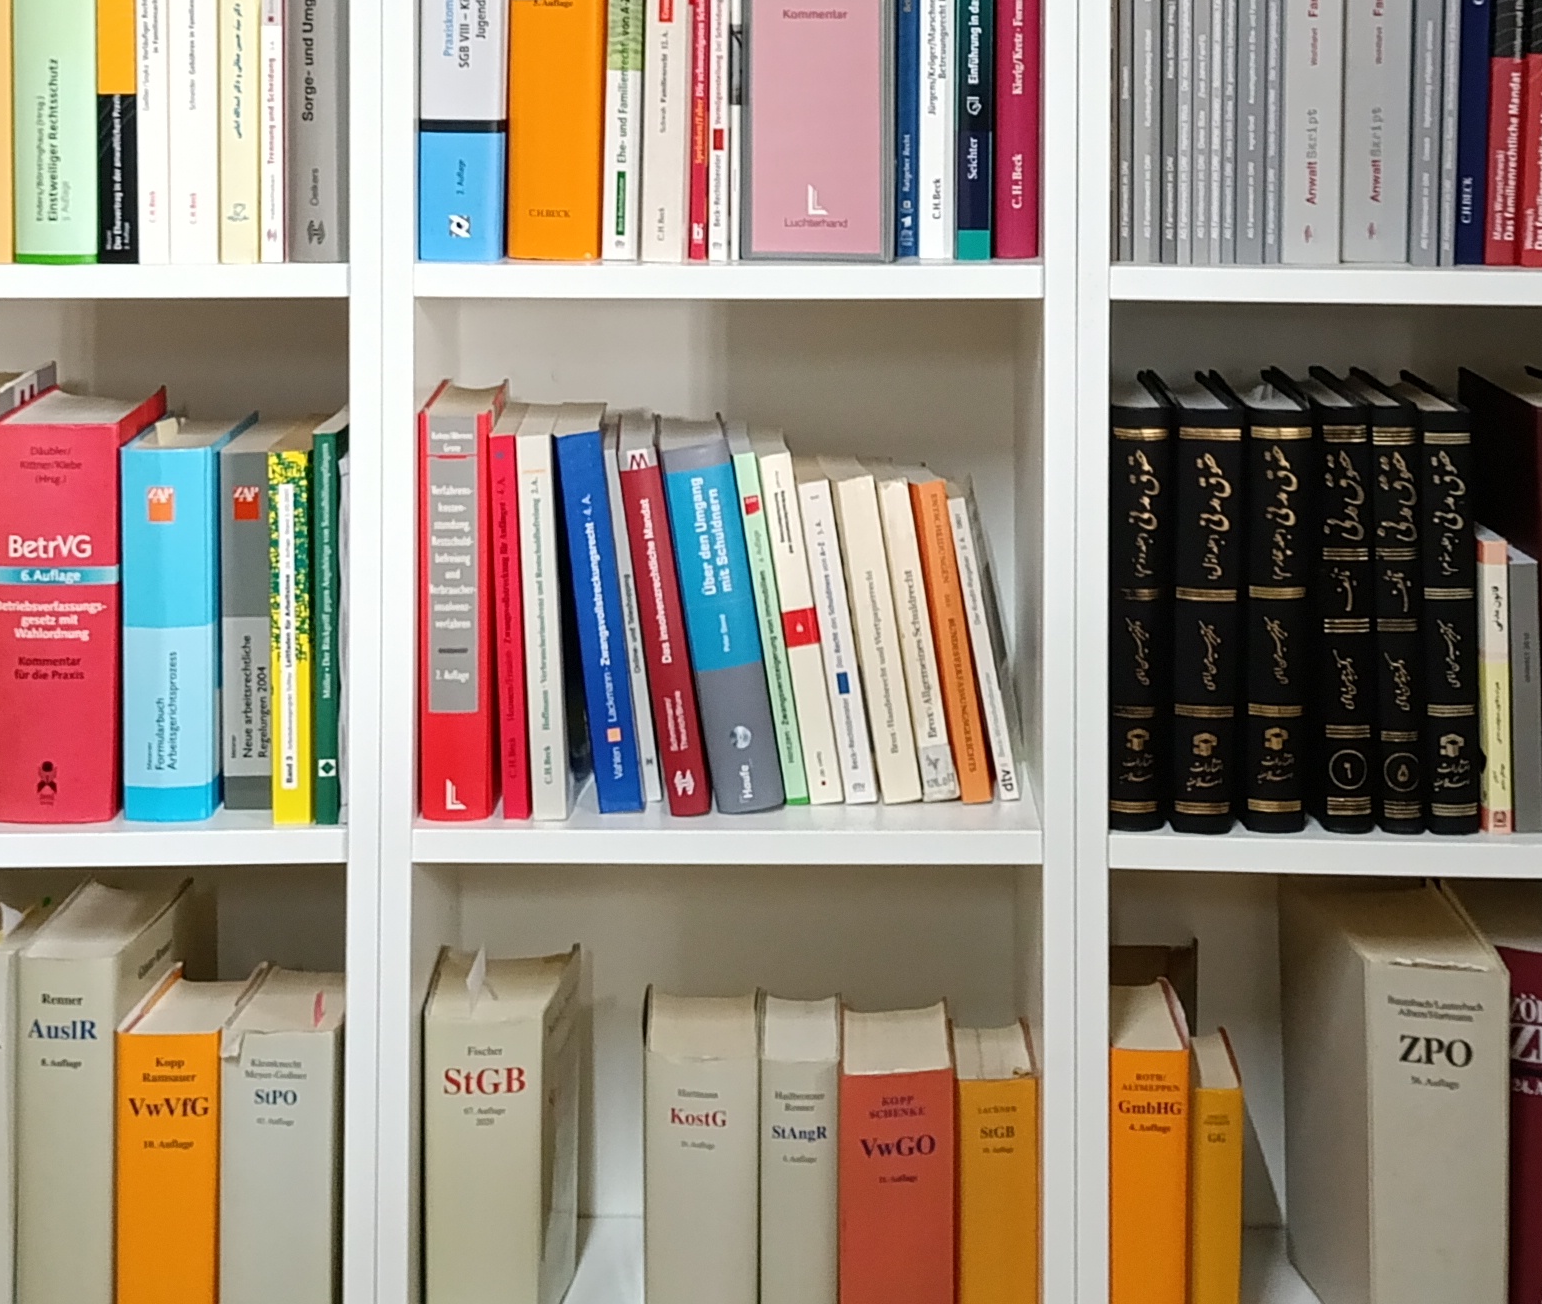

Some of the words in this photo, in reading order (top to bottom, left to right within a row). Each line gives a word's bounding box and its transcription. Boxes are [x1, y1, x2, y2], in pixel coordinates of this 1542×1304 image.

[783, 8, 847, 21] Kommentar
[303, 42, 315, 68] und
[302, 72, 316, 122] Sorge-
[784, 217, 847, 230] Luchterhand
[691, 477, 708, 532] Umgang
[709, 489, 728, 565] Schuldnern
[8, 534, 93, 560] BetrVG
[699, 536, 711, 558] den
[21, 570, 33, 583] 6.
[34, 568, 81, 585] Auflage
[702, 565, 717, 597] Über
[720, 568, 733, 592] mit
[18, 655, 81, 669] Kommentar
[167, 651, 177, 771] Arbeitsgerichtsprozess
[155, 695, 165, 771] Formularbuch
[28, 1018, 97, 1042] AuslR
[1399, 1034, 1473, 1069] ZPO
[444, 1066, 527, 1096] StGB
[129, 1098, 210, 1119] VwVfG
[253, 1088, 297, 1107] StPO
[1118, 1099, 1182, 1117] GmbHG
[670, 1106, 727, 1129] KostG
[772, 1124, 827, 1143] StAngR
[980, 1124, 1015, 1139] StGB
[860, 1135, 937, 1158] VwGO
